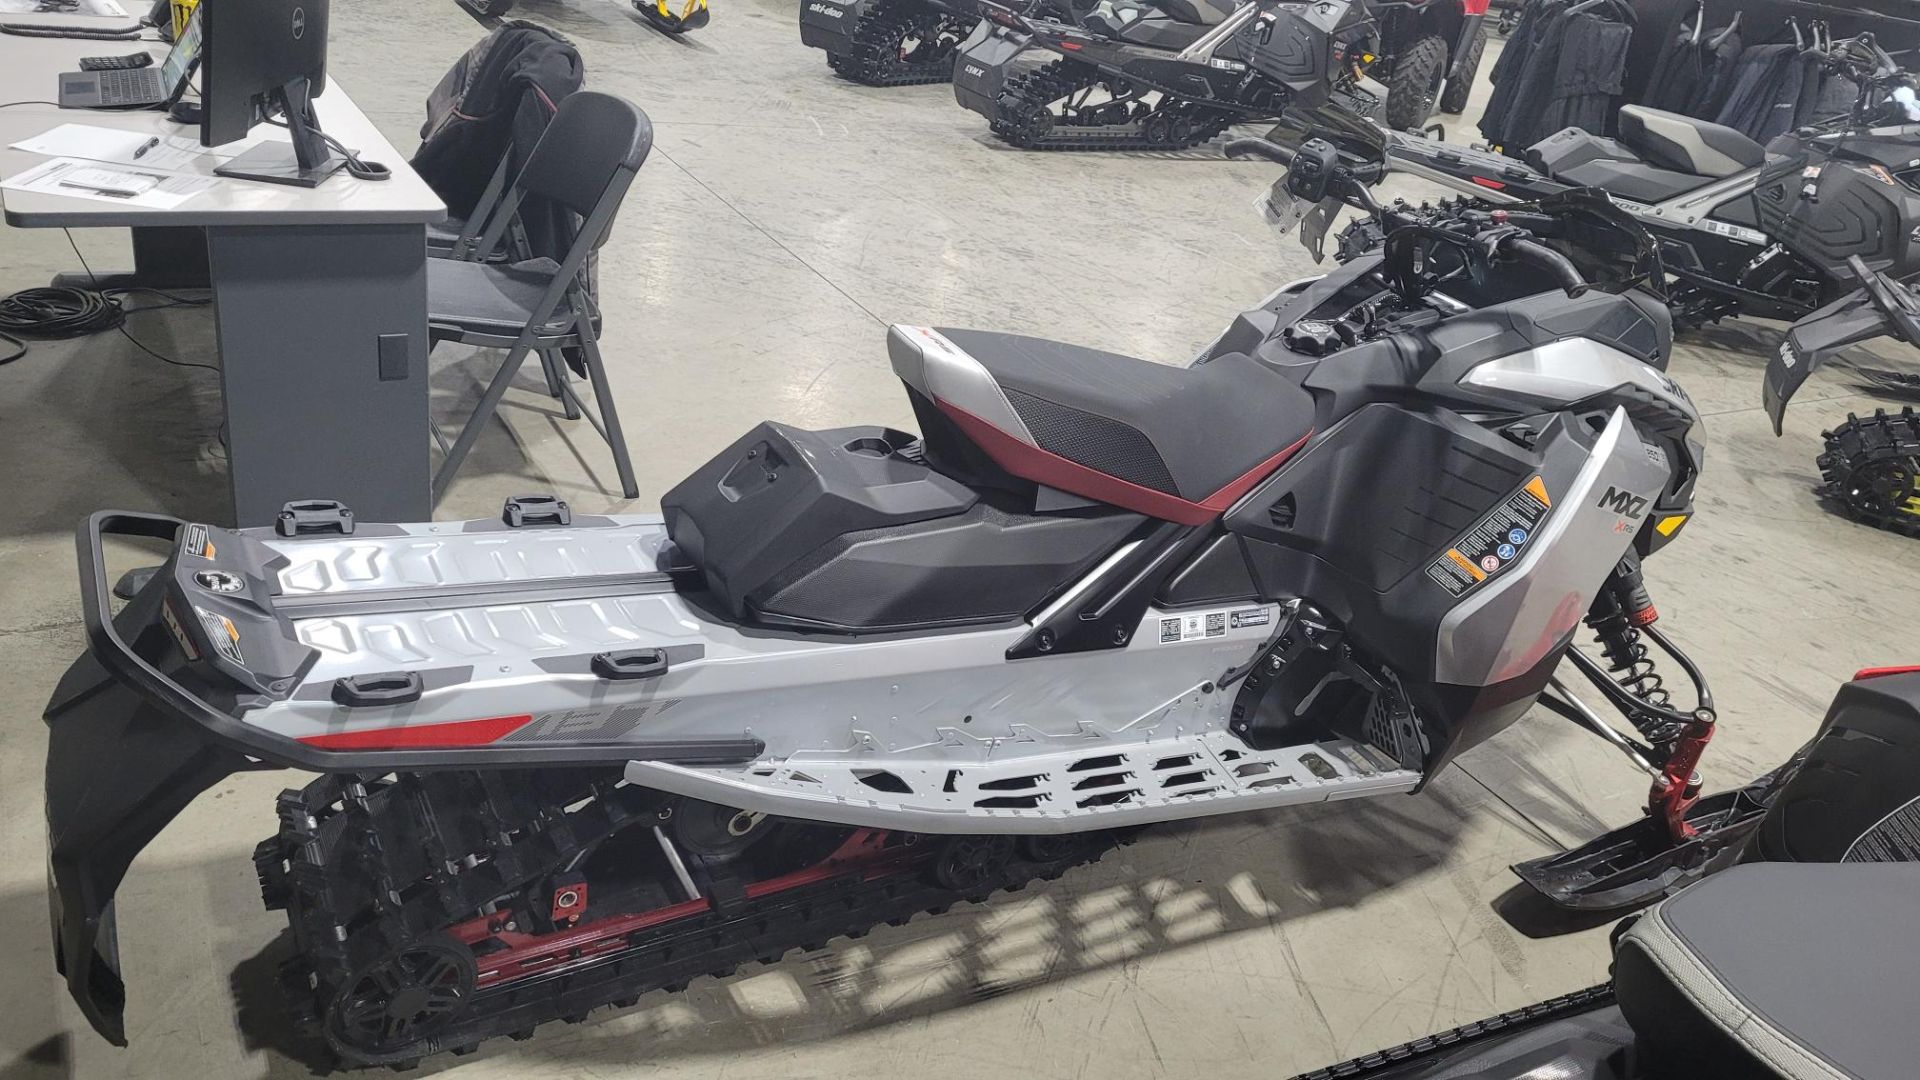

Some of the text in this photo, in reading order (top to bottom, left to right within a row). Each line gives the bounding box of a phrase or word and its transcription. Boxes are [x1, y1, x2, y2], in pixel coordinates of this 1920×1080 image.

[809, 3, 844, 19] ski-doo
[964, 64, 985, 78] LYNX
[1597, 486, 1649, 520] MXZ
